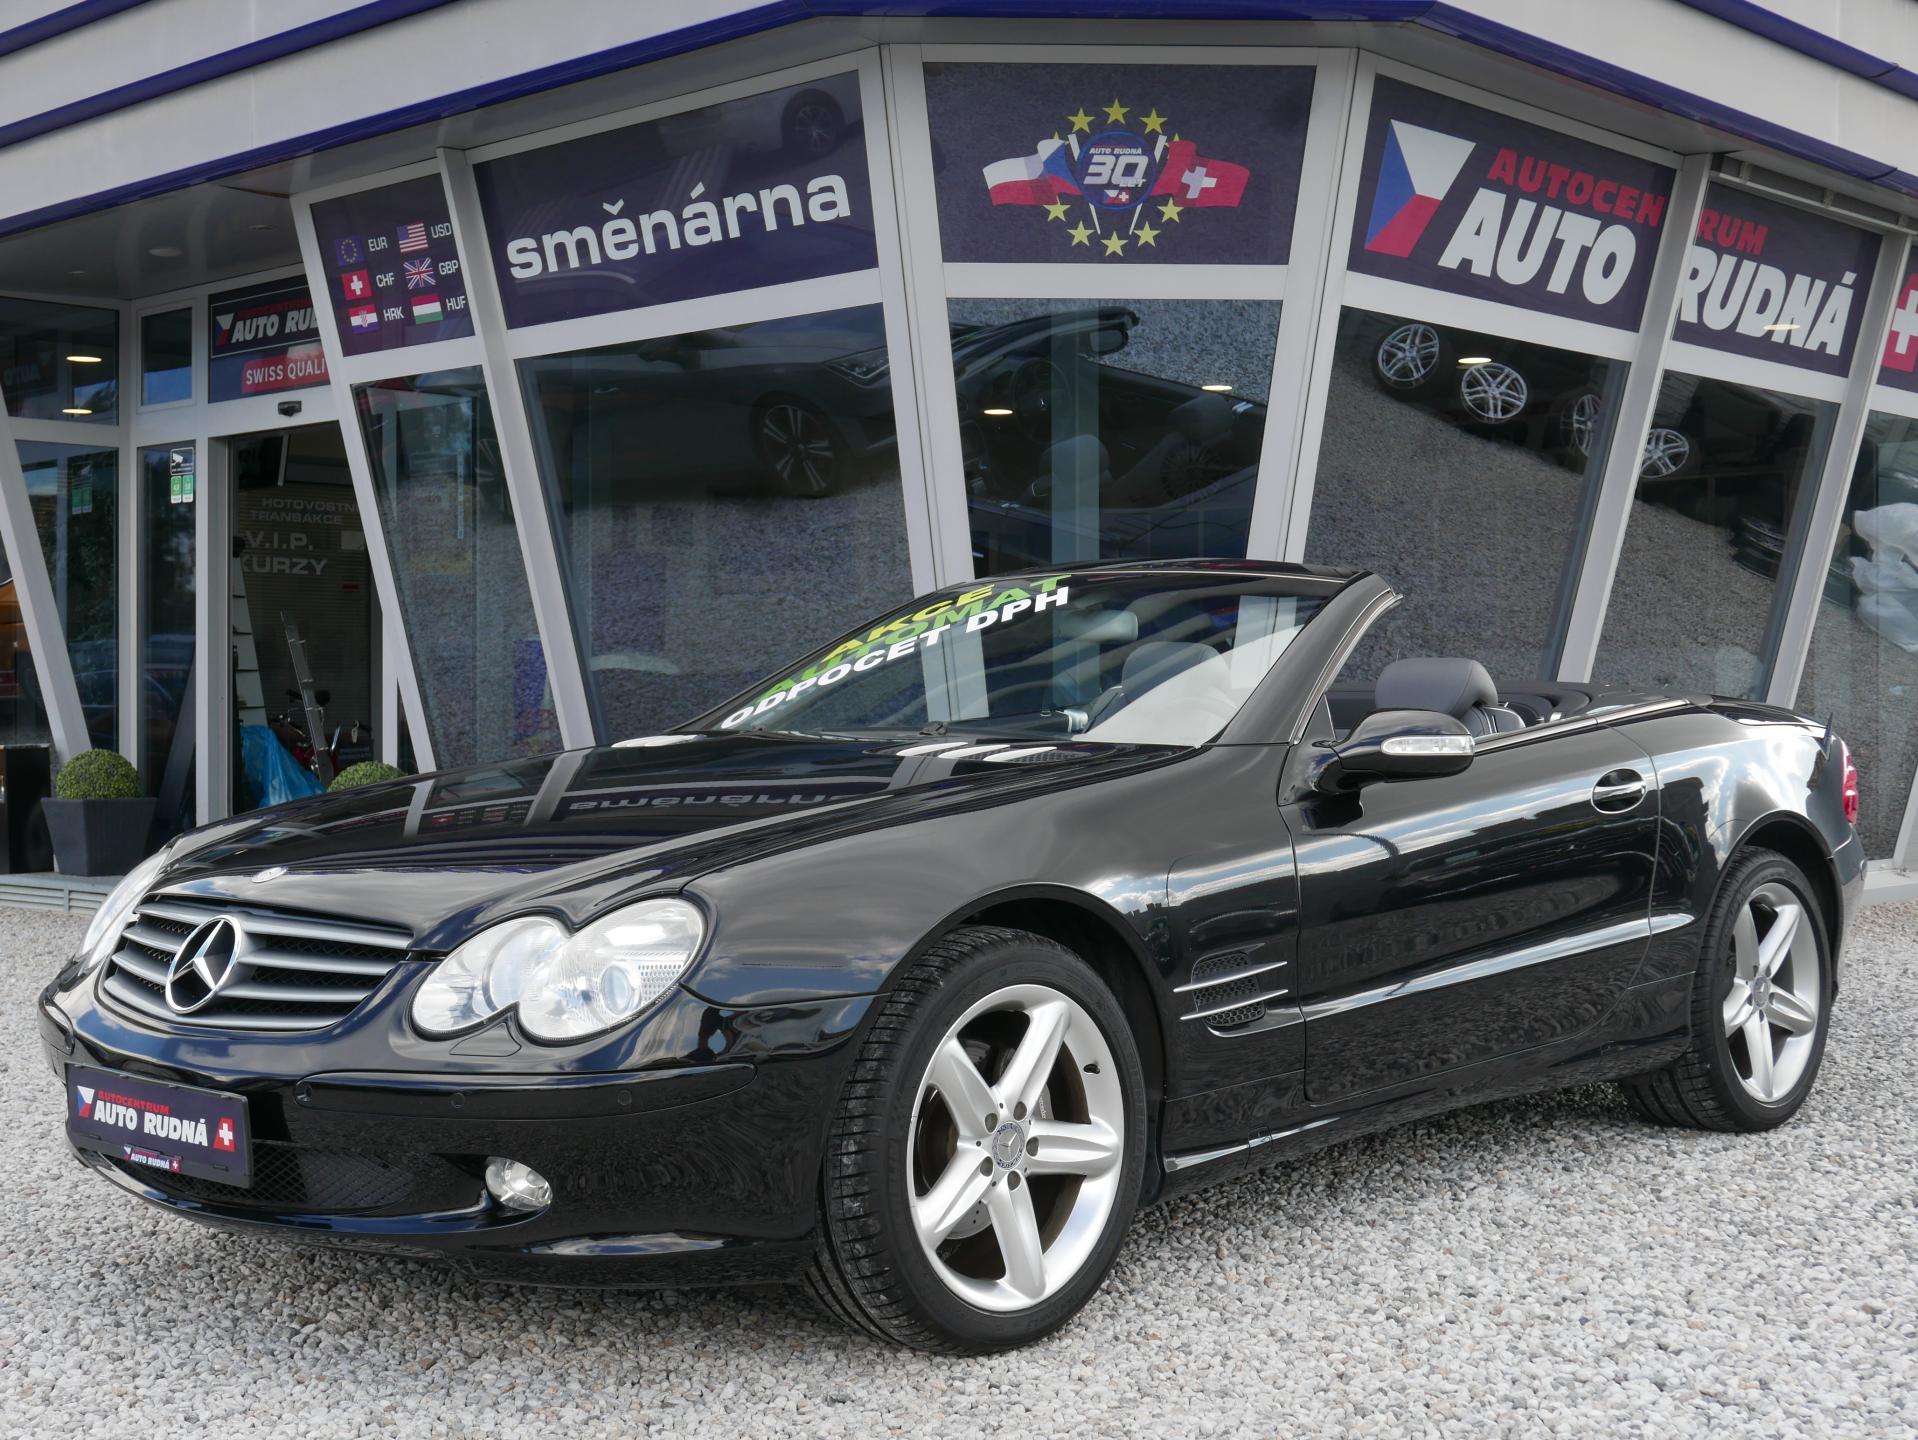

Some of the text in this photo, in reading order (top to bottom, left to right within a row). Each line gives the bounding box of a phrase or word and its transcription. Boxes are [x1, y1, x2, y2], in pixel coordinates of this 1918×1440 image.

[1083, 154, 1149, 185] 30
[368, 222, 453, 252] EUR USD
[507, 173, 851, 279] směnárna
[1437, 187, 1636, 305] AUTO
[376, 259, 459, 288] CHF GBP
[383, 295, 466, 322] HRK HUF
[231, 314, 280, 344] AUTO
[246, 365, 284, 385] SWISS
[720, 586, 1070, 729] ODPOCET DPH
[97, 1090, 170, 1114] AUTOCENTRUM
[94, 1100, 208, 1147] AUTO RUDNÁ
